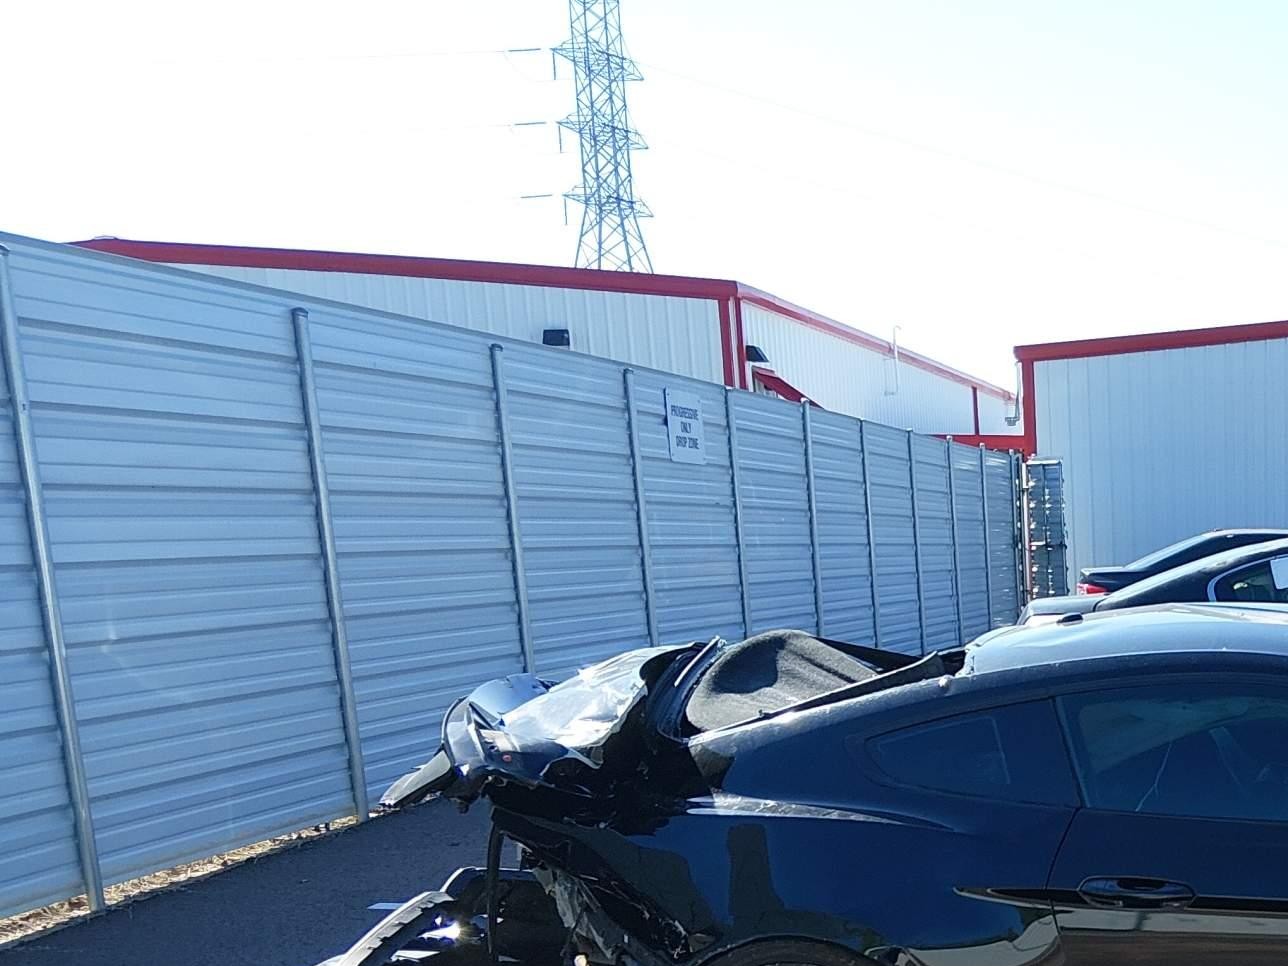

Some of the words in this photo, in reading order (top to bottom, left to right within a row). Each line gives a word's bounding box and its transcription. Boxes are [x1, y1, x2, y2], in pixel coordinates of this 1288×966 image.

[680, 421, 691, 434] ONLY
[676, 435, 687, 448] DROP
[688, 437, 699, 450] ZONE
